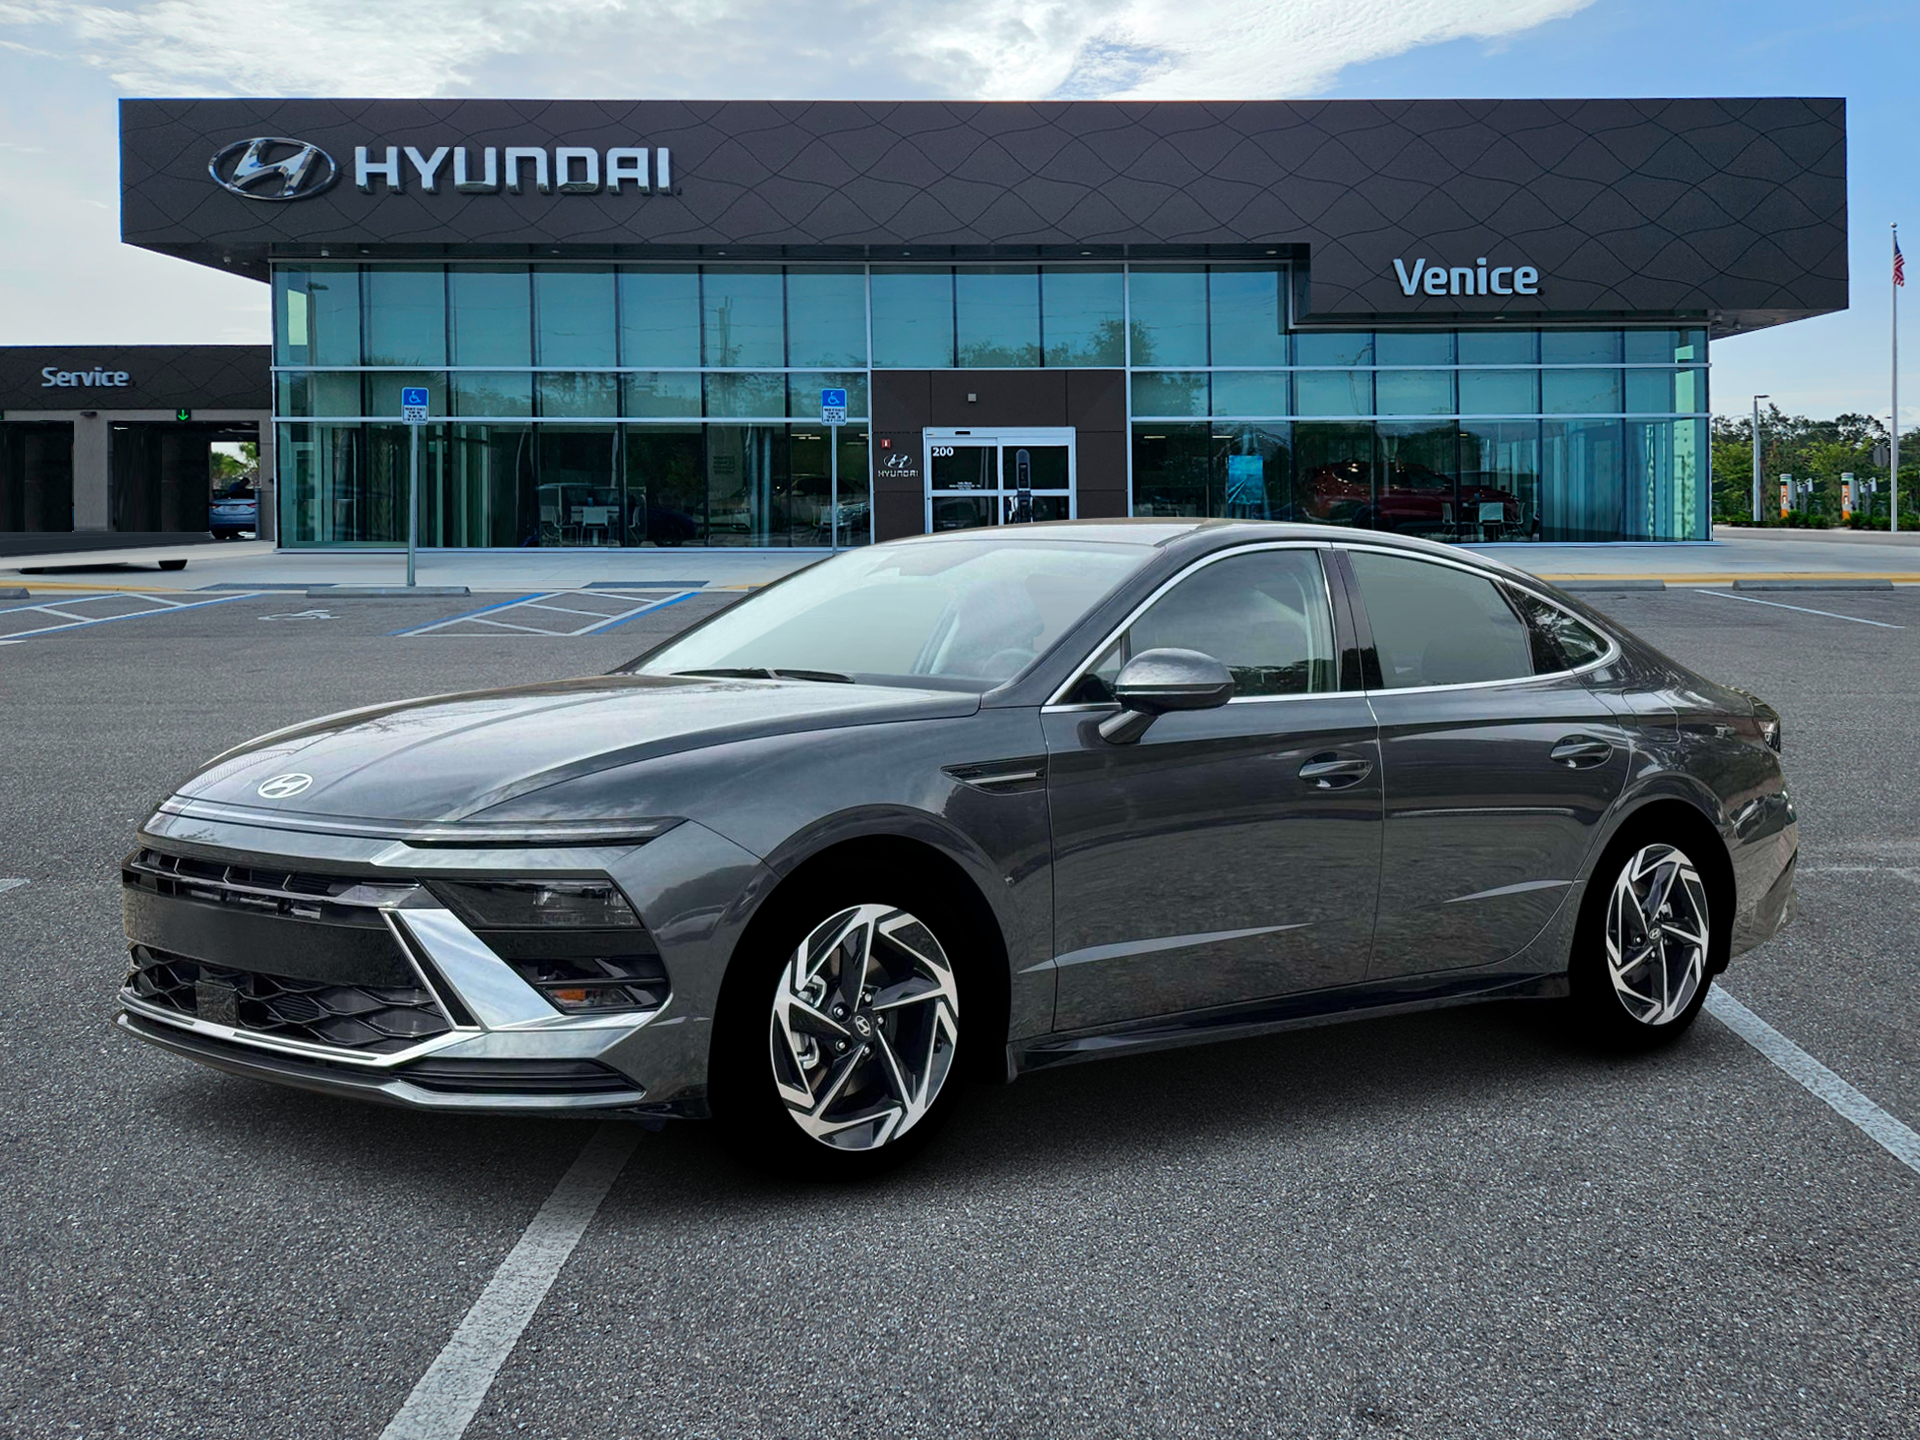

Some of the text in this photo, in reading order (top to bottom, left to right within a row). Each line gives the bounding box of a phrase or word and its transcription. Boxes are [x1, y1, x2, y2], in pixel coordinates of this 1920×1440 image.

[354, 146, 673, 194] HYUNDAI
[1393, 257, 1539, 296] Venice
[41, 366, 130, 387] Service
[932, 446, 954, 457] 200
[877, 470, 919, 478] HYUNDAI
